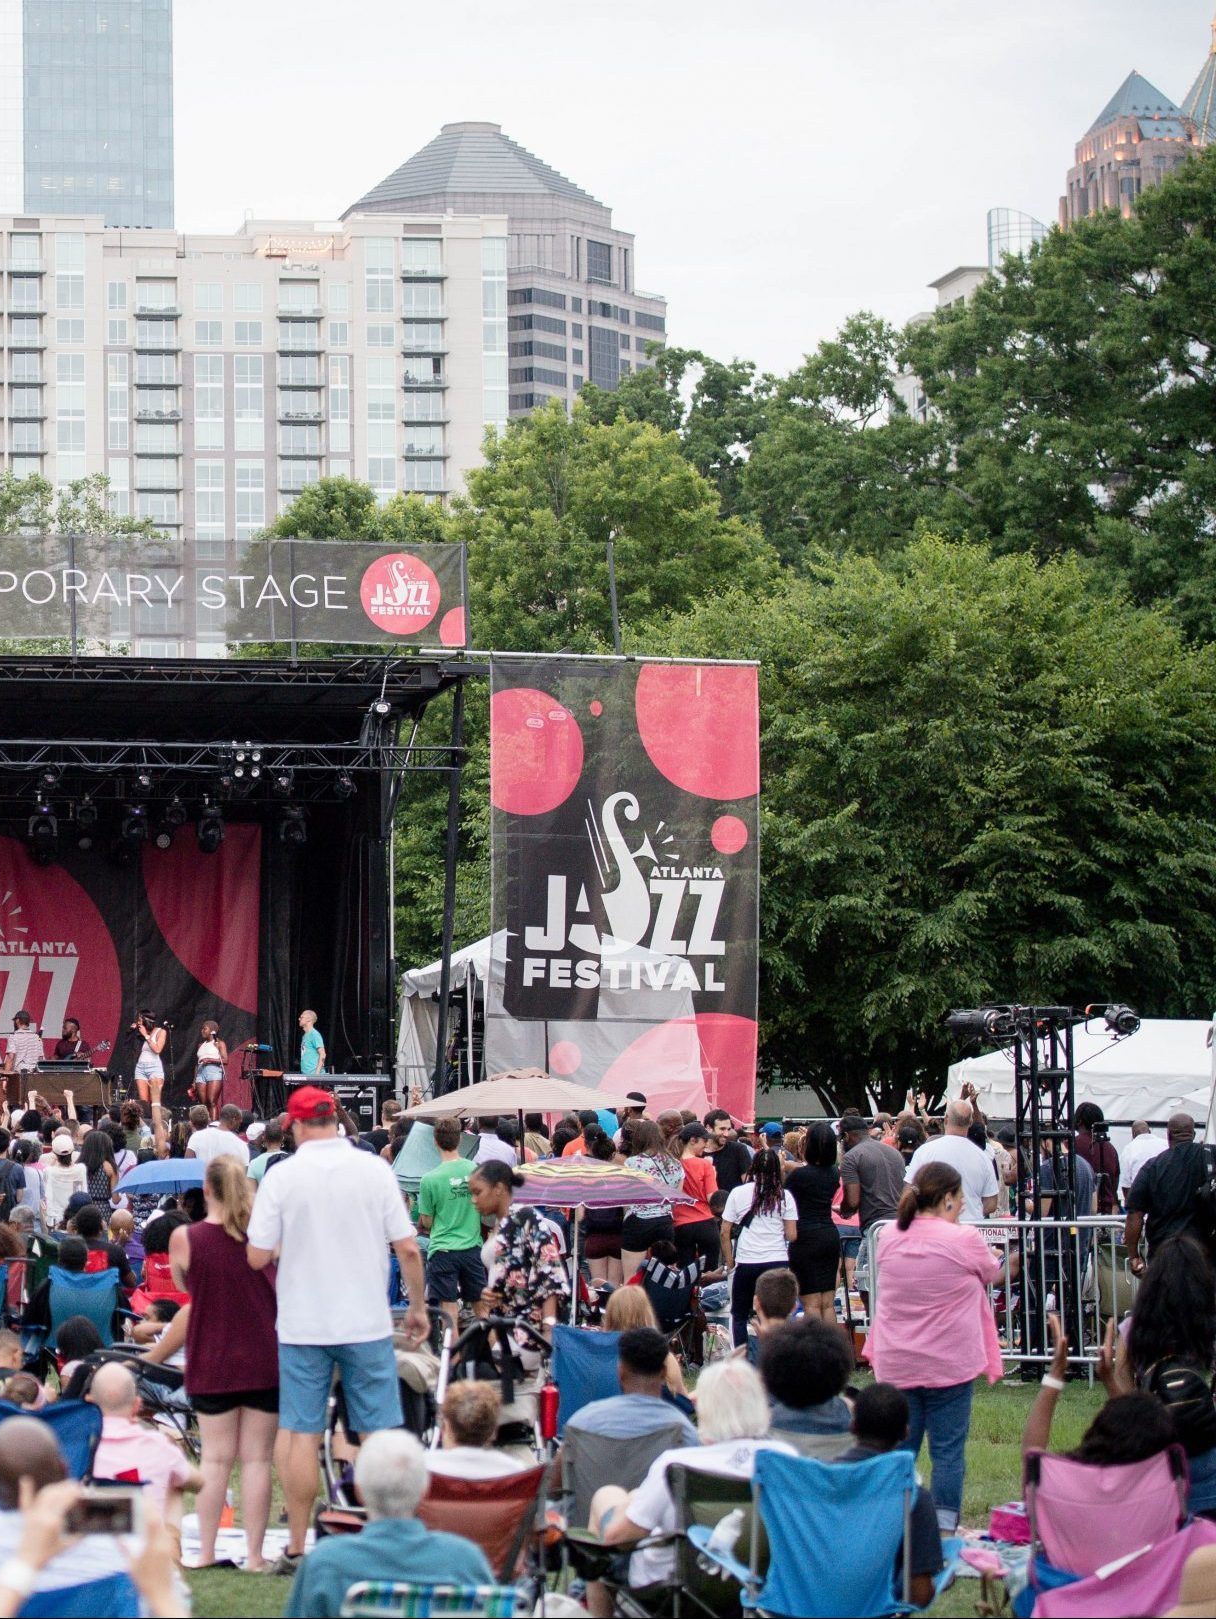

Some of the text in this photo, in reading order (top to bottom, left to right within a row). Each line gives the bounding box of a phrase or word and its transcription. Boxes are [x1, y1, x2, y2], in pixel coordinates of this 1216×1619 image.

[201, 573, 348, 610] STAGE
[371, 583, 431, 606] JAZZ
[371, 606, 431, 616] FESTIVAL
[650, 866, 724, 879] ATLANTA
[524, 874, 726, 956] JAZZ
[522, 957, 726, 992] FESTIVAL
